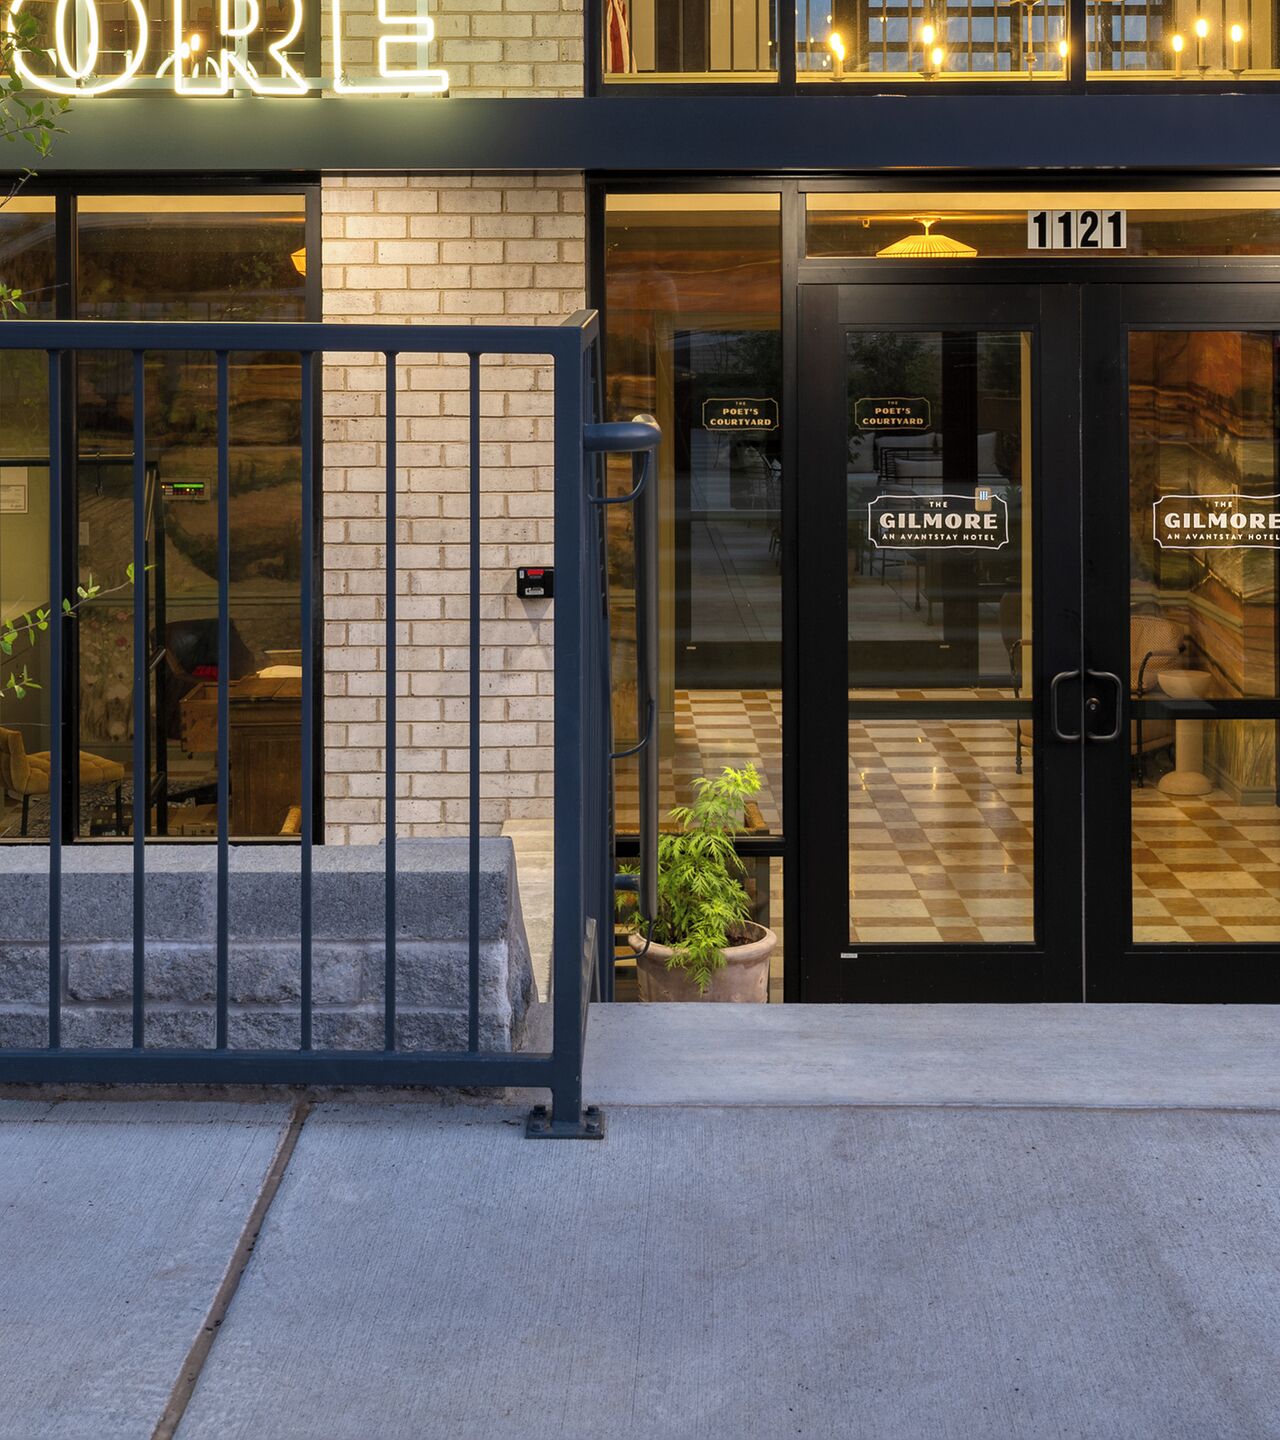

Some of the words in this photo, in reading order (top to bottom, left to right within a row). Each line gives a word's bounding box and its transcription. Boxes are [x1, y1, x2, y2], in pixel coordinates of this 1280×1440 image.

[1033, 211, 1121, 247] 1121
[874, 407, 911, 415] POET'S
[710, 418, 772, 426] COURTYARD
[862, 417, 924, 425] COURTYARD
[879, 512, 998, 529] GILMORE
